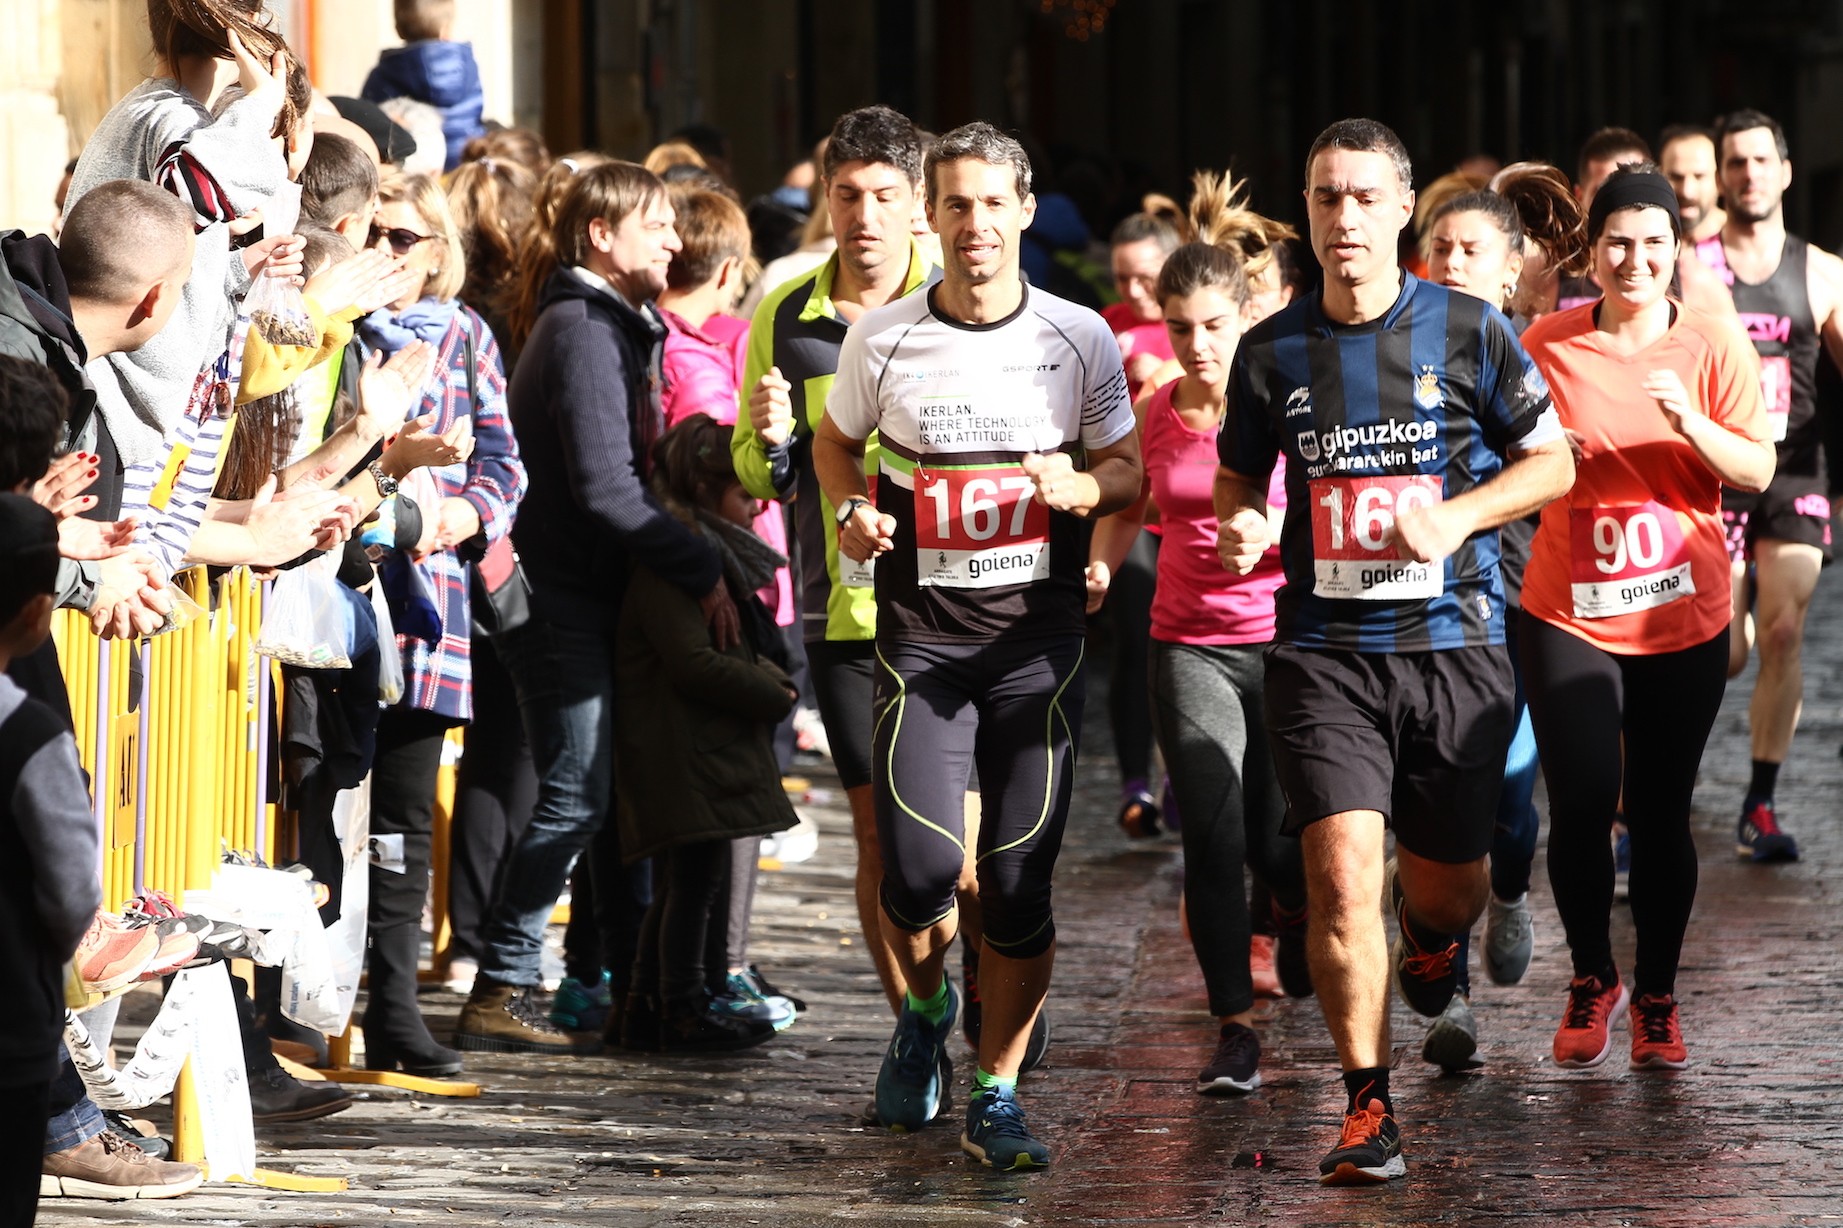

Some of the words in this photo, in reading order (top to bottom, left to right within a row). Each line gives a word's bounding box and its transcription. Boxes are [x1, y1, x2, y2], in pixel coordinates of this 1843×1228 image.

[919, 404, 976, 417] IKERLAN.
[919, 419, 963, 432] WHERE
[968, 415, 1047, 429] TECHNOLOGY
[919, 434, 930, 445] IS
[934, 433, 951, 444] AN
[956, 430, 1015, 443] ATTITUDE
[1322, 418, 1438, 459] gipuzkoa
[1411, 444, 1439, 464] bat
[924, 476, 1037, 541] 167
[1593, 512, 1664, 575] 90
[969, 552, 1033, 579] goiena
[1361, 563, 1427, 589] goiena
[1621, 575, 1680, 605] goiena
